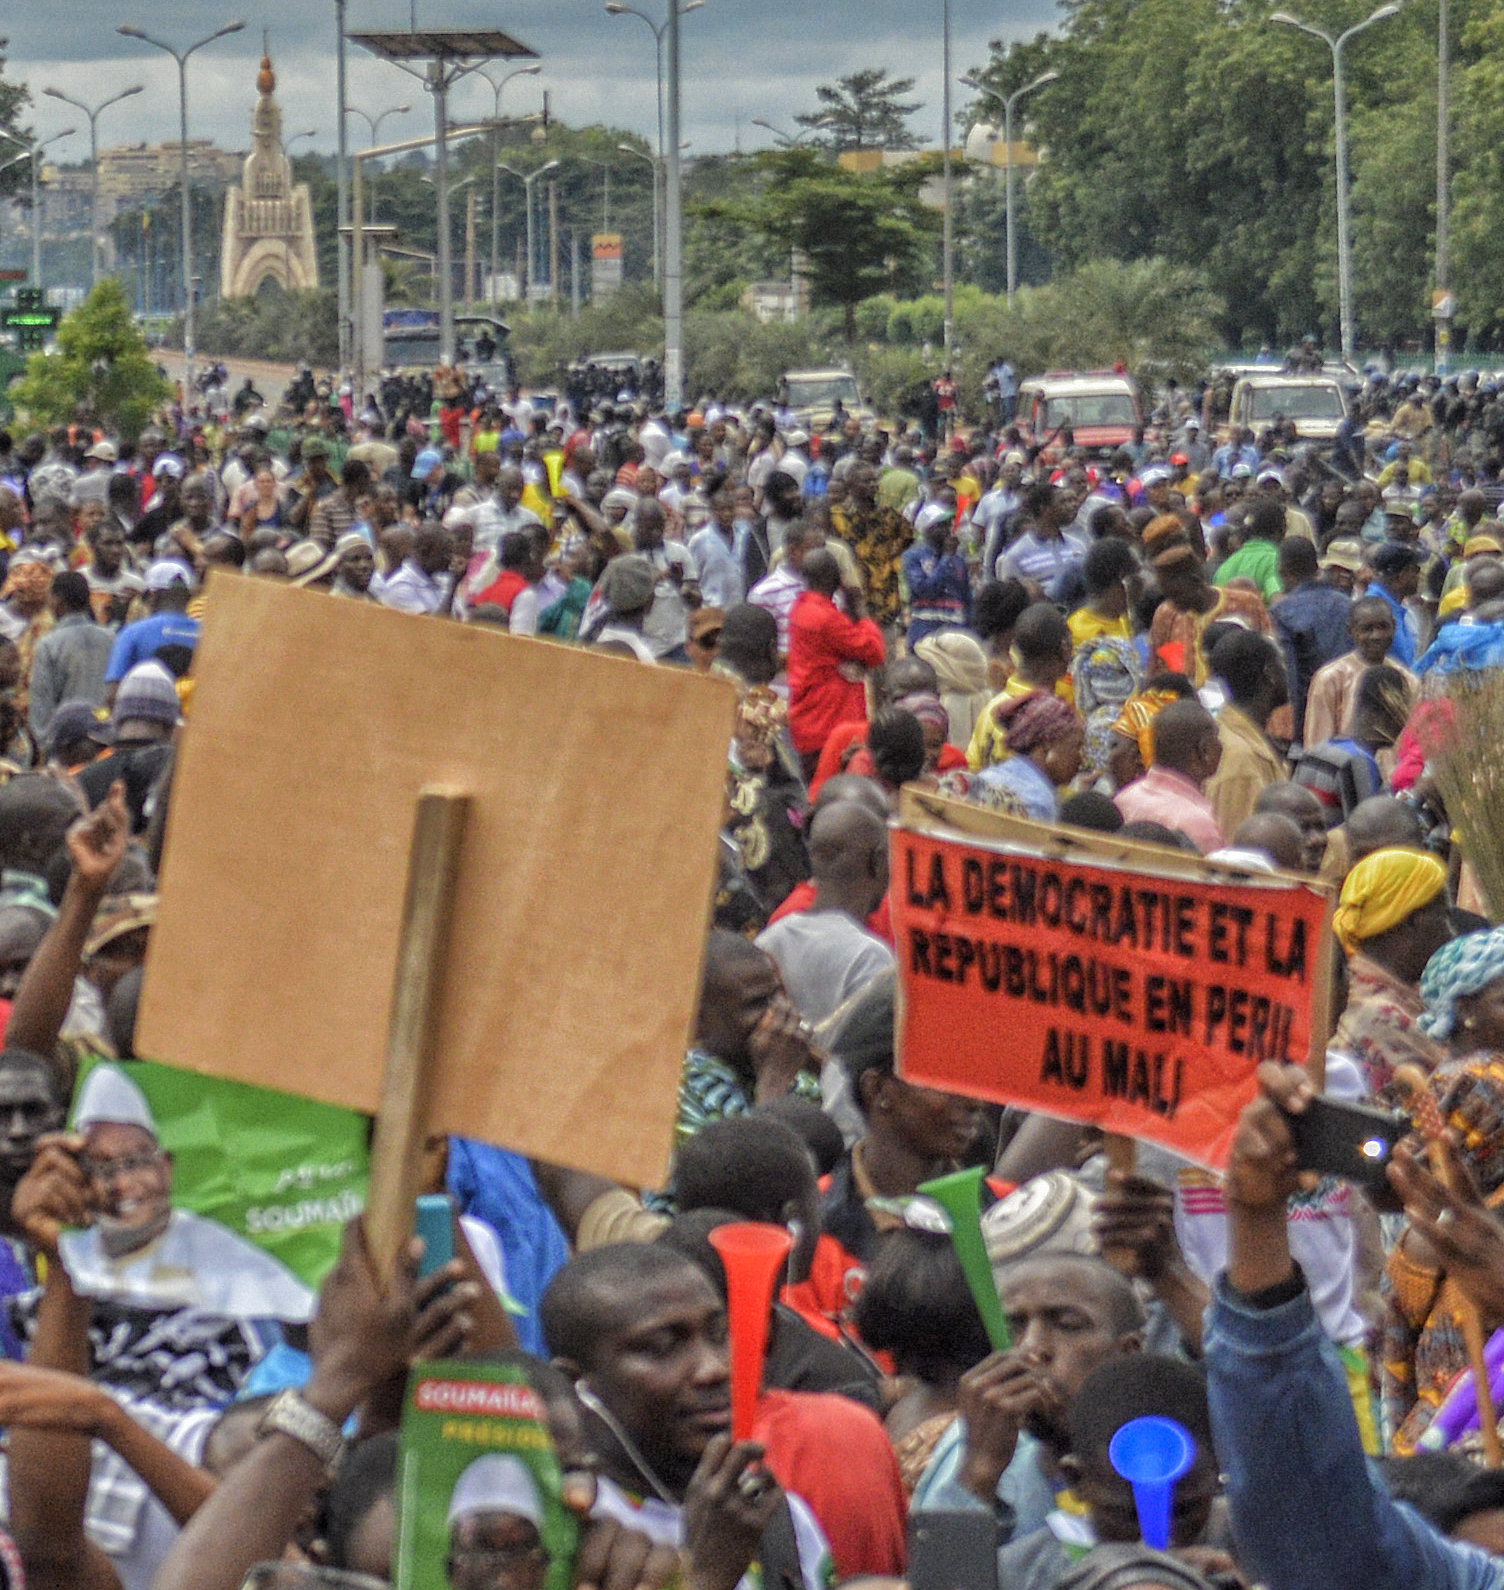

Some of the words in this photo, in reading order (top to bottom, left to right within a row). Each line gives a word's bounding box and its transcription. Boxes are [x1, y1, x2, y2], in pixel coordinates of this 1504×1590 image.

[905, 848, 951, 914] LA
[1207, 900, 1253, 966] ET
[1265, 912, 1310, 984] LA
[1144, 973, 1193, 1038] EN
[1204, 984, 1294, 1066] PERIL
[1039, 1025, 1091, 1091] AU
[1100, 1037, 1186, 1121] MALI
